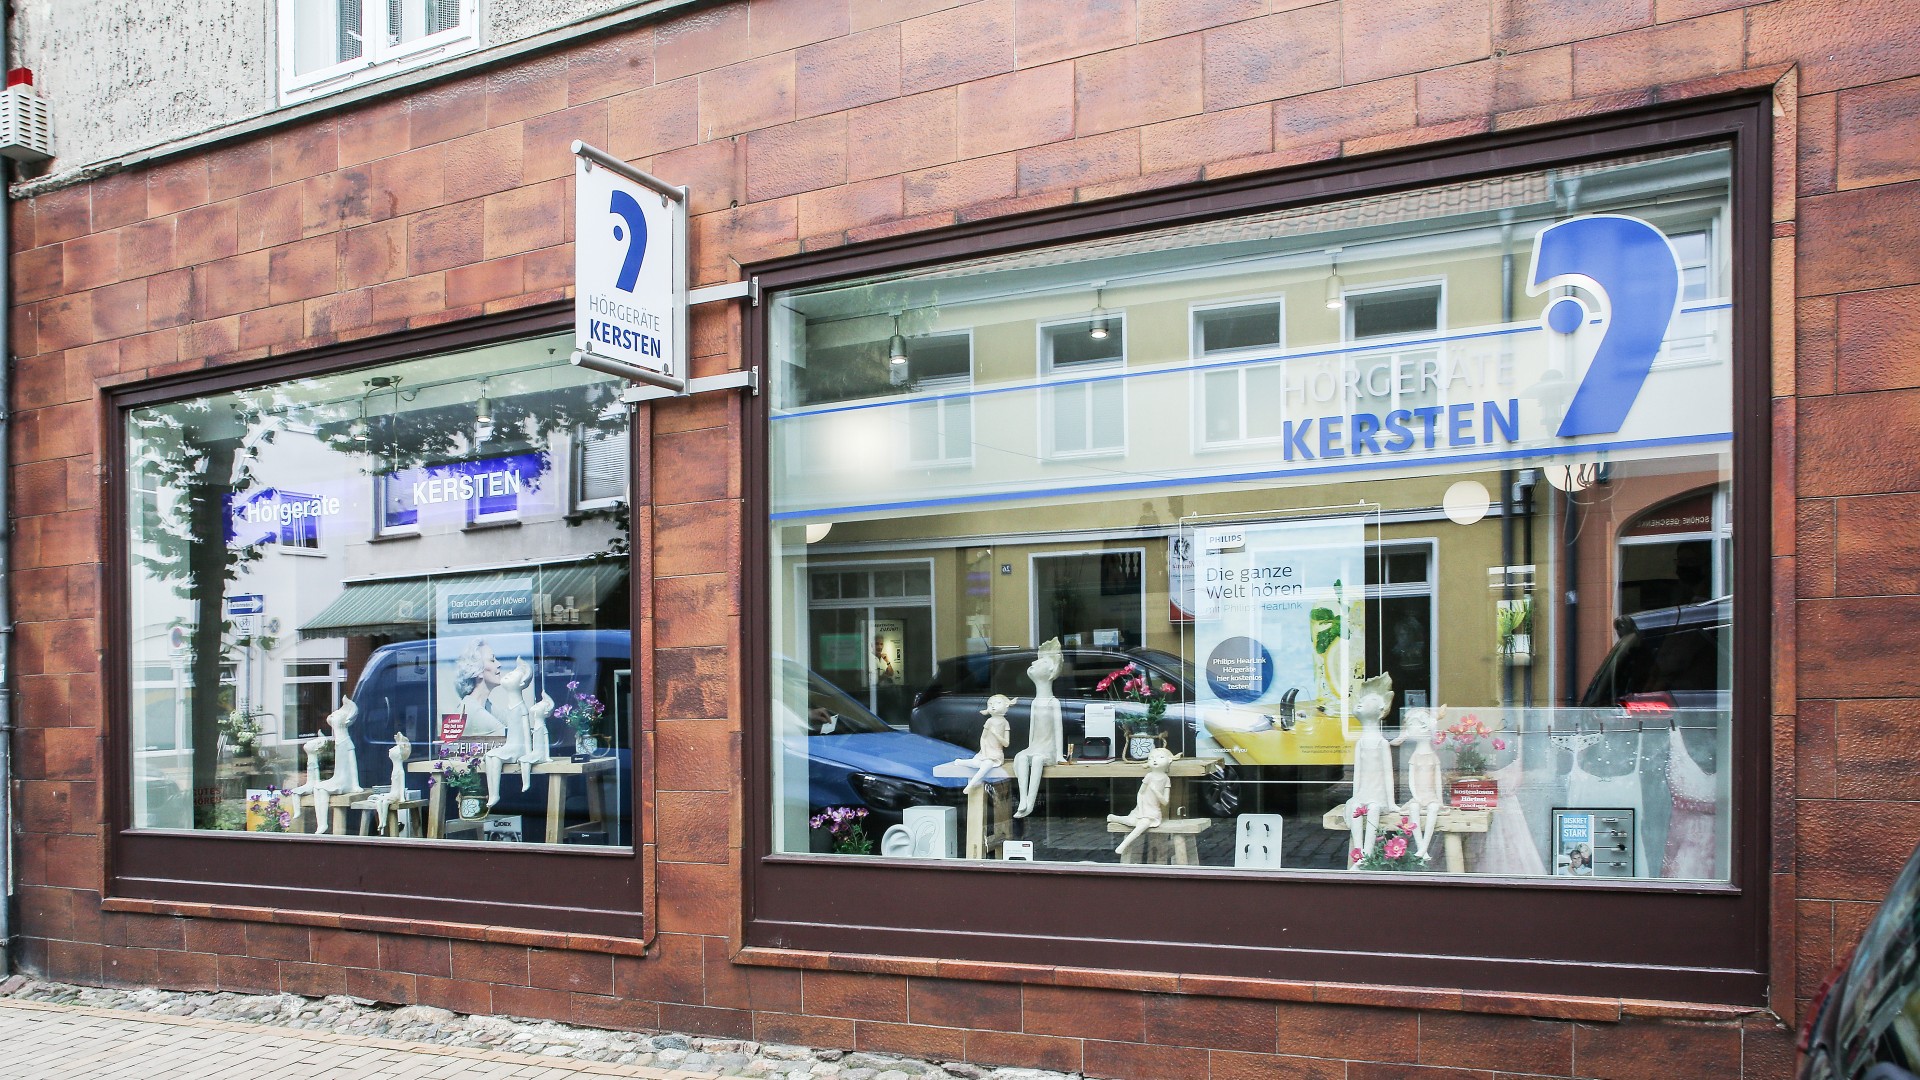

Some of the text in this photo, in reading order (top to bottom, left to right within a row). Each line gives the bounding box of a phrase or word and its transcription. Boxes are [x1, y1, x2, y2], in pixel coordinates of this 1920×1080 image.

[589, 294, 660, 332] HÖRGERÄTE
[590, 319, 661, 358] KERSTEN
[1282, 345, 1516, 406] HÖRGERÄTE
[1284, 398, 1519, 461] KERSTEN
[414, 470, 520, 506] KERSTEN
[247, 495, 340, 526] Hörgeräte
[1210, 534, 1242, 543] PHILIPS
[1206, 567, 1234, 582] Die
[1240, 566, 1292, 582] ganze
[464, 598, 489, 607] Lachen
[502, 596, 527, 605] Möwen
[1206, 582, 1302, 599] Welt hören
[1564, 829, 1587, 837] STARK
